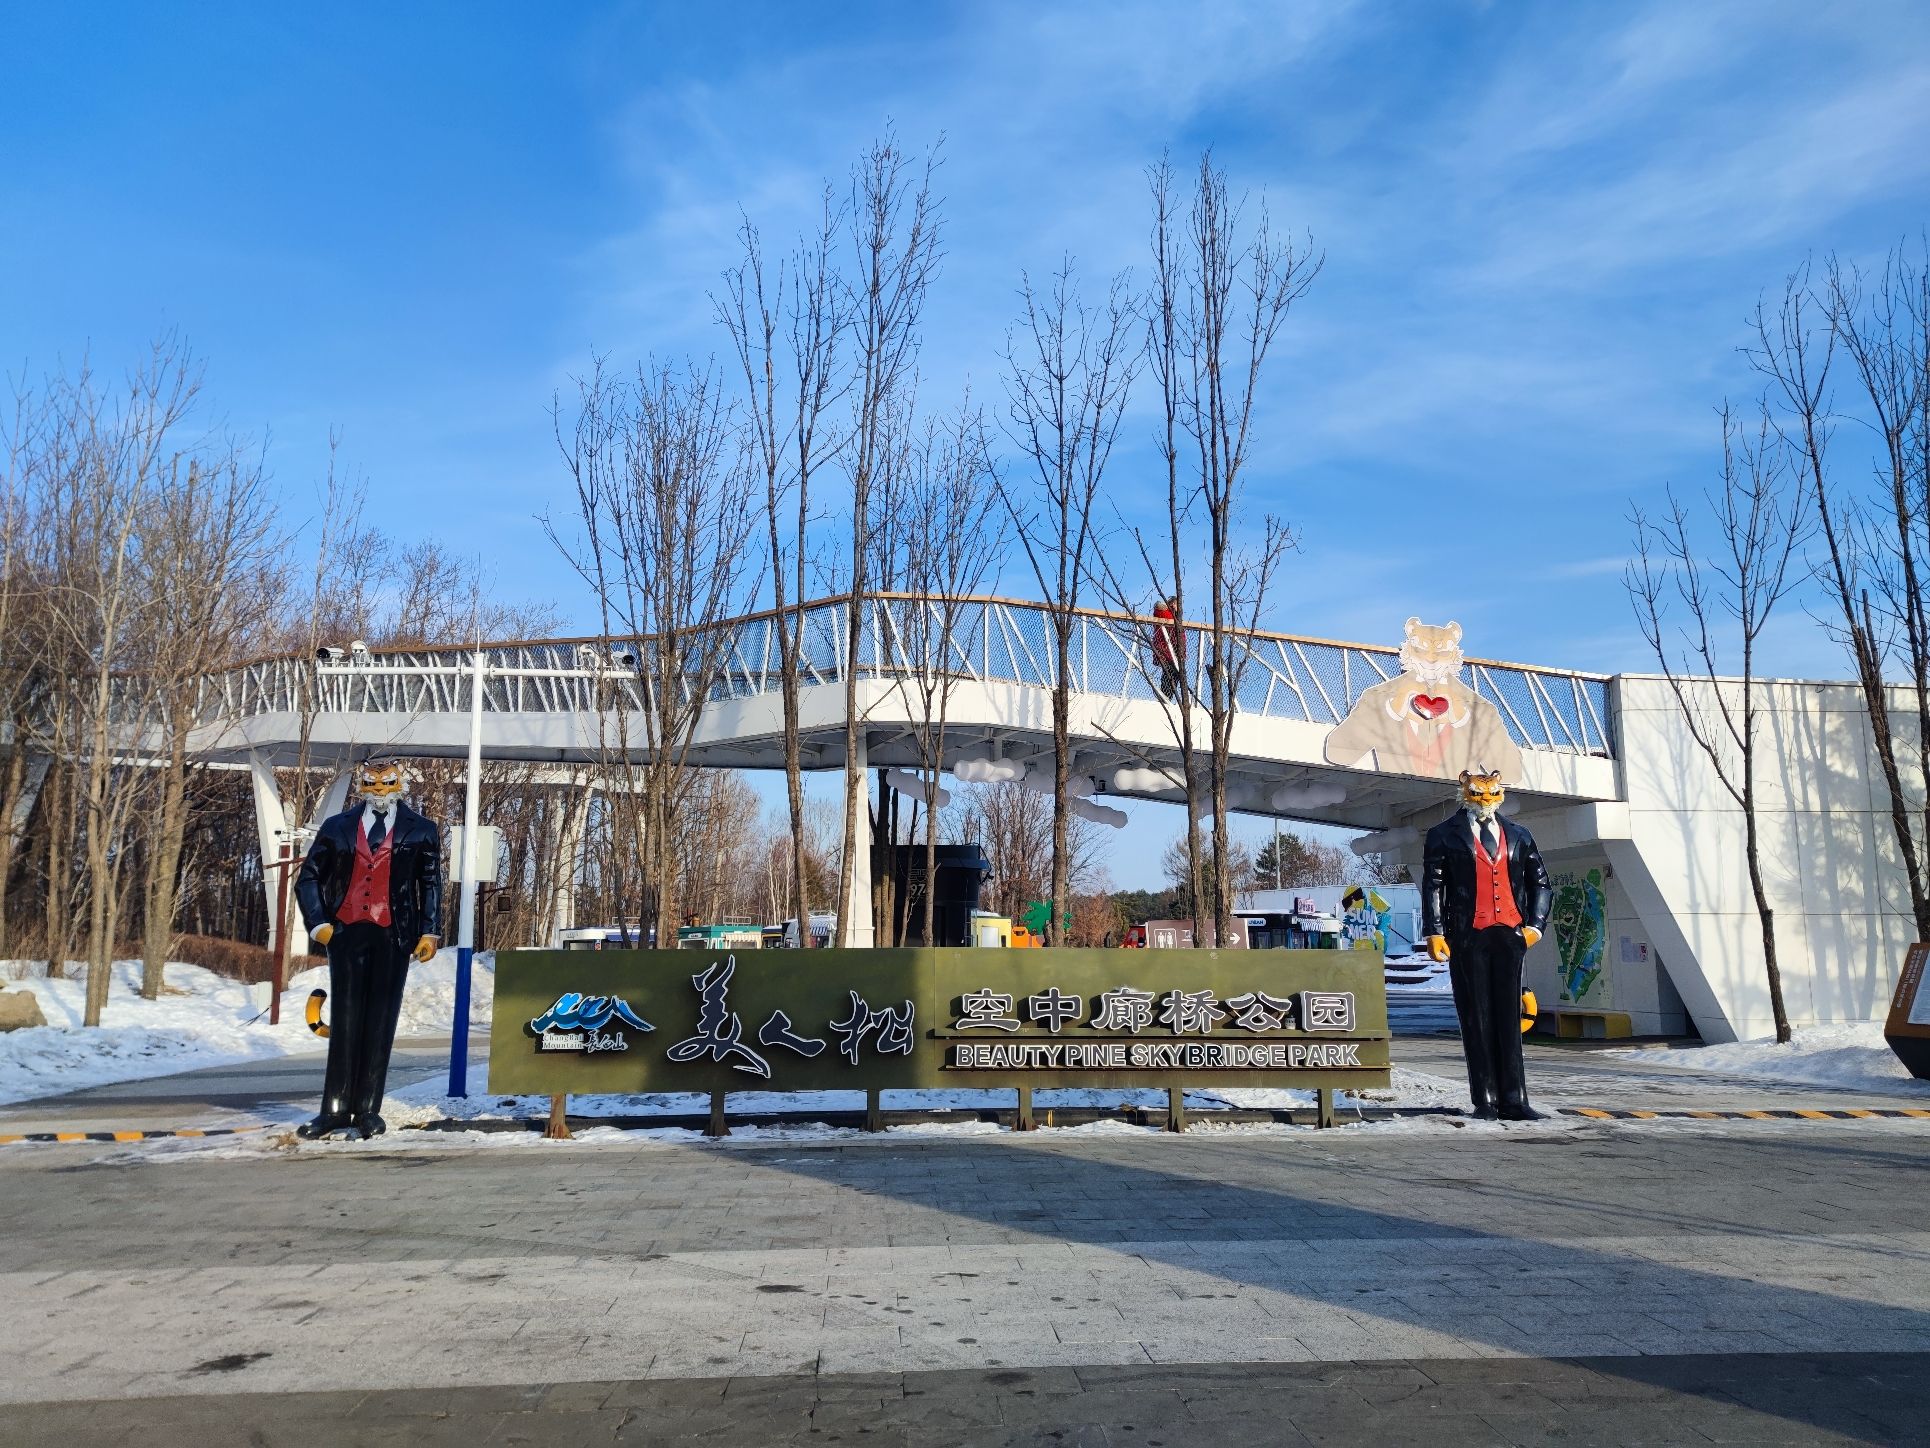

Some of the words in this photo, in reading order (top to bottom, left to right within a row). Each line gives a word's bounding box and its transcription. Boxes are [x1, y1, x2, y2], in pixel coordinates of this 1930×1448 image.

[667, 954, 915, 1078] 美人松
[956, 987, 1357, 1033] 空中廊桥公园
[543, 1041, 583, 1049] Mountain
[956, 1045, 1062, 1067] BEAUTY
[1065, 1045, 1126, 1067] PINE
[1130, 1044, 1185, 1067] SKY
[1187, 1043, 1287, 1067] BRIDGE
[1288, 1045, 1362, 1067] PARK
